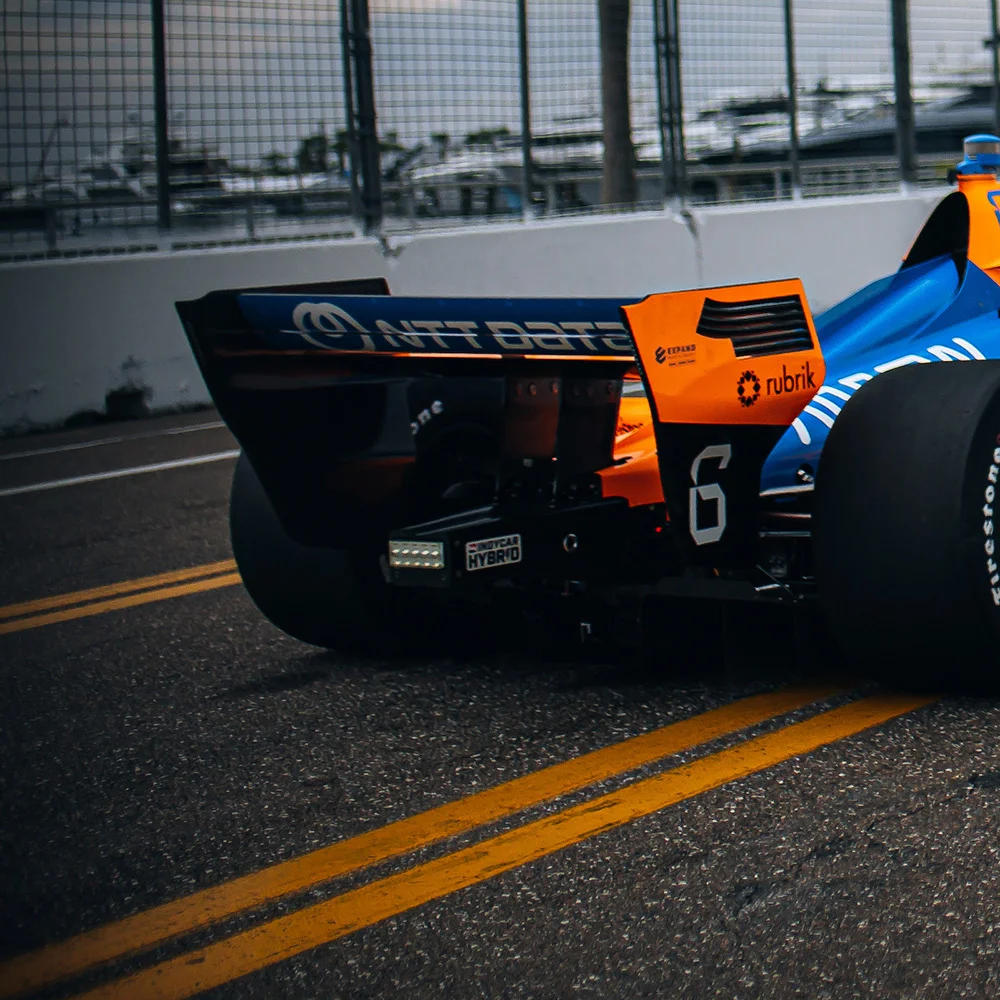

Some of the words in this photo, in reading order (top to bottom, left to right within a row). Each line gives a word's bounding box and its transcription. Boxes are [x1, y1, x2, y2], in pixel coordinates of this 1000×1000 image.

[375, 320, 482, 349] NTT
[766, 361, 816, 396] rubrik
[689, 443, 732, 546] 6
[468, 546, 520, 569] HYBRID
